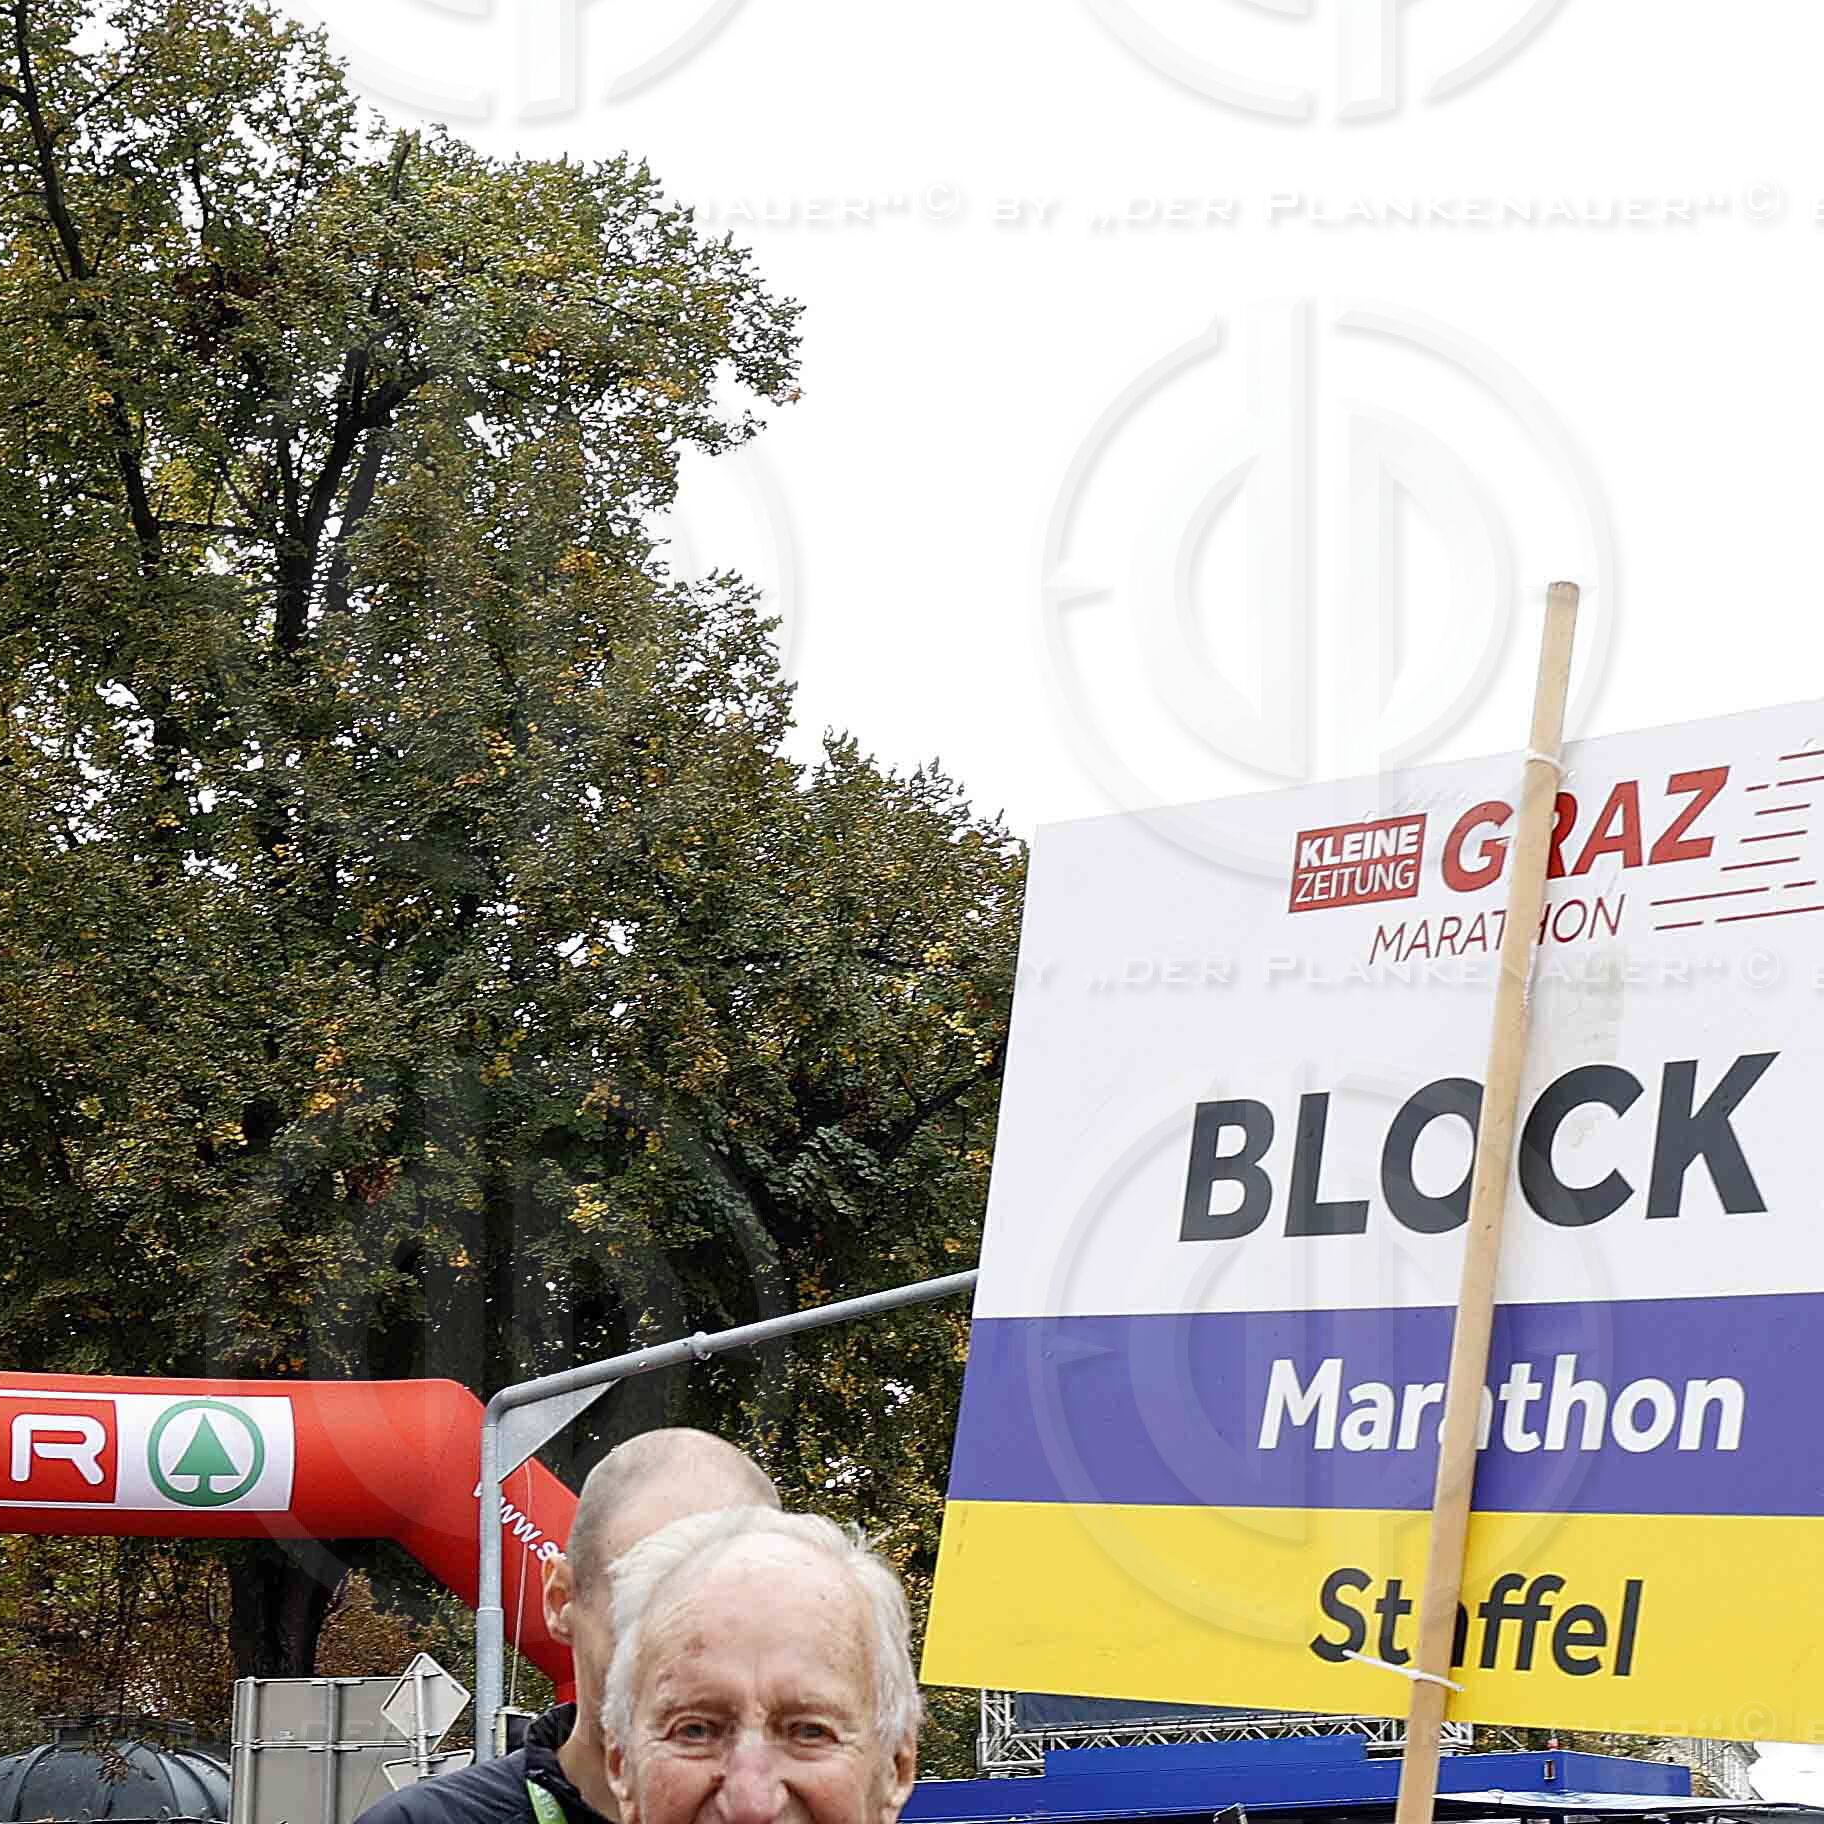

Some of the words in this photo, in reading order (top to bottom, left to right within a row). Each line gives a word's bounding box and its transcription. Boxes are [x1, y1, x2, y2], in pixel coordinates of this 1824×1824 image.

[1301, 823, 1420, 868] KLEINE
[1294, 857, 1416, 904] ZEITUNG
[1178, 1050, 1783, 1242] BLOCK
